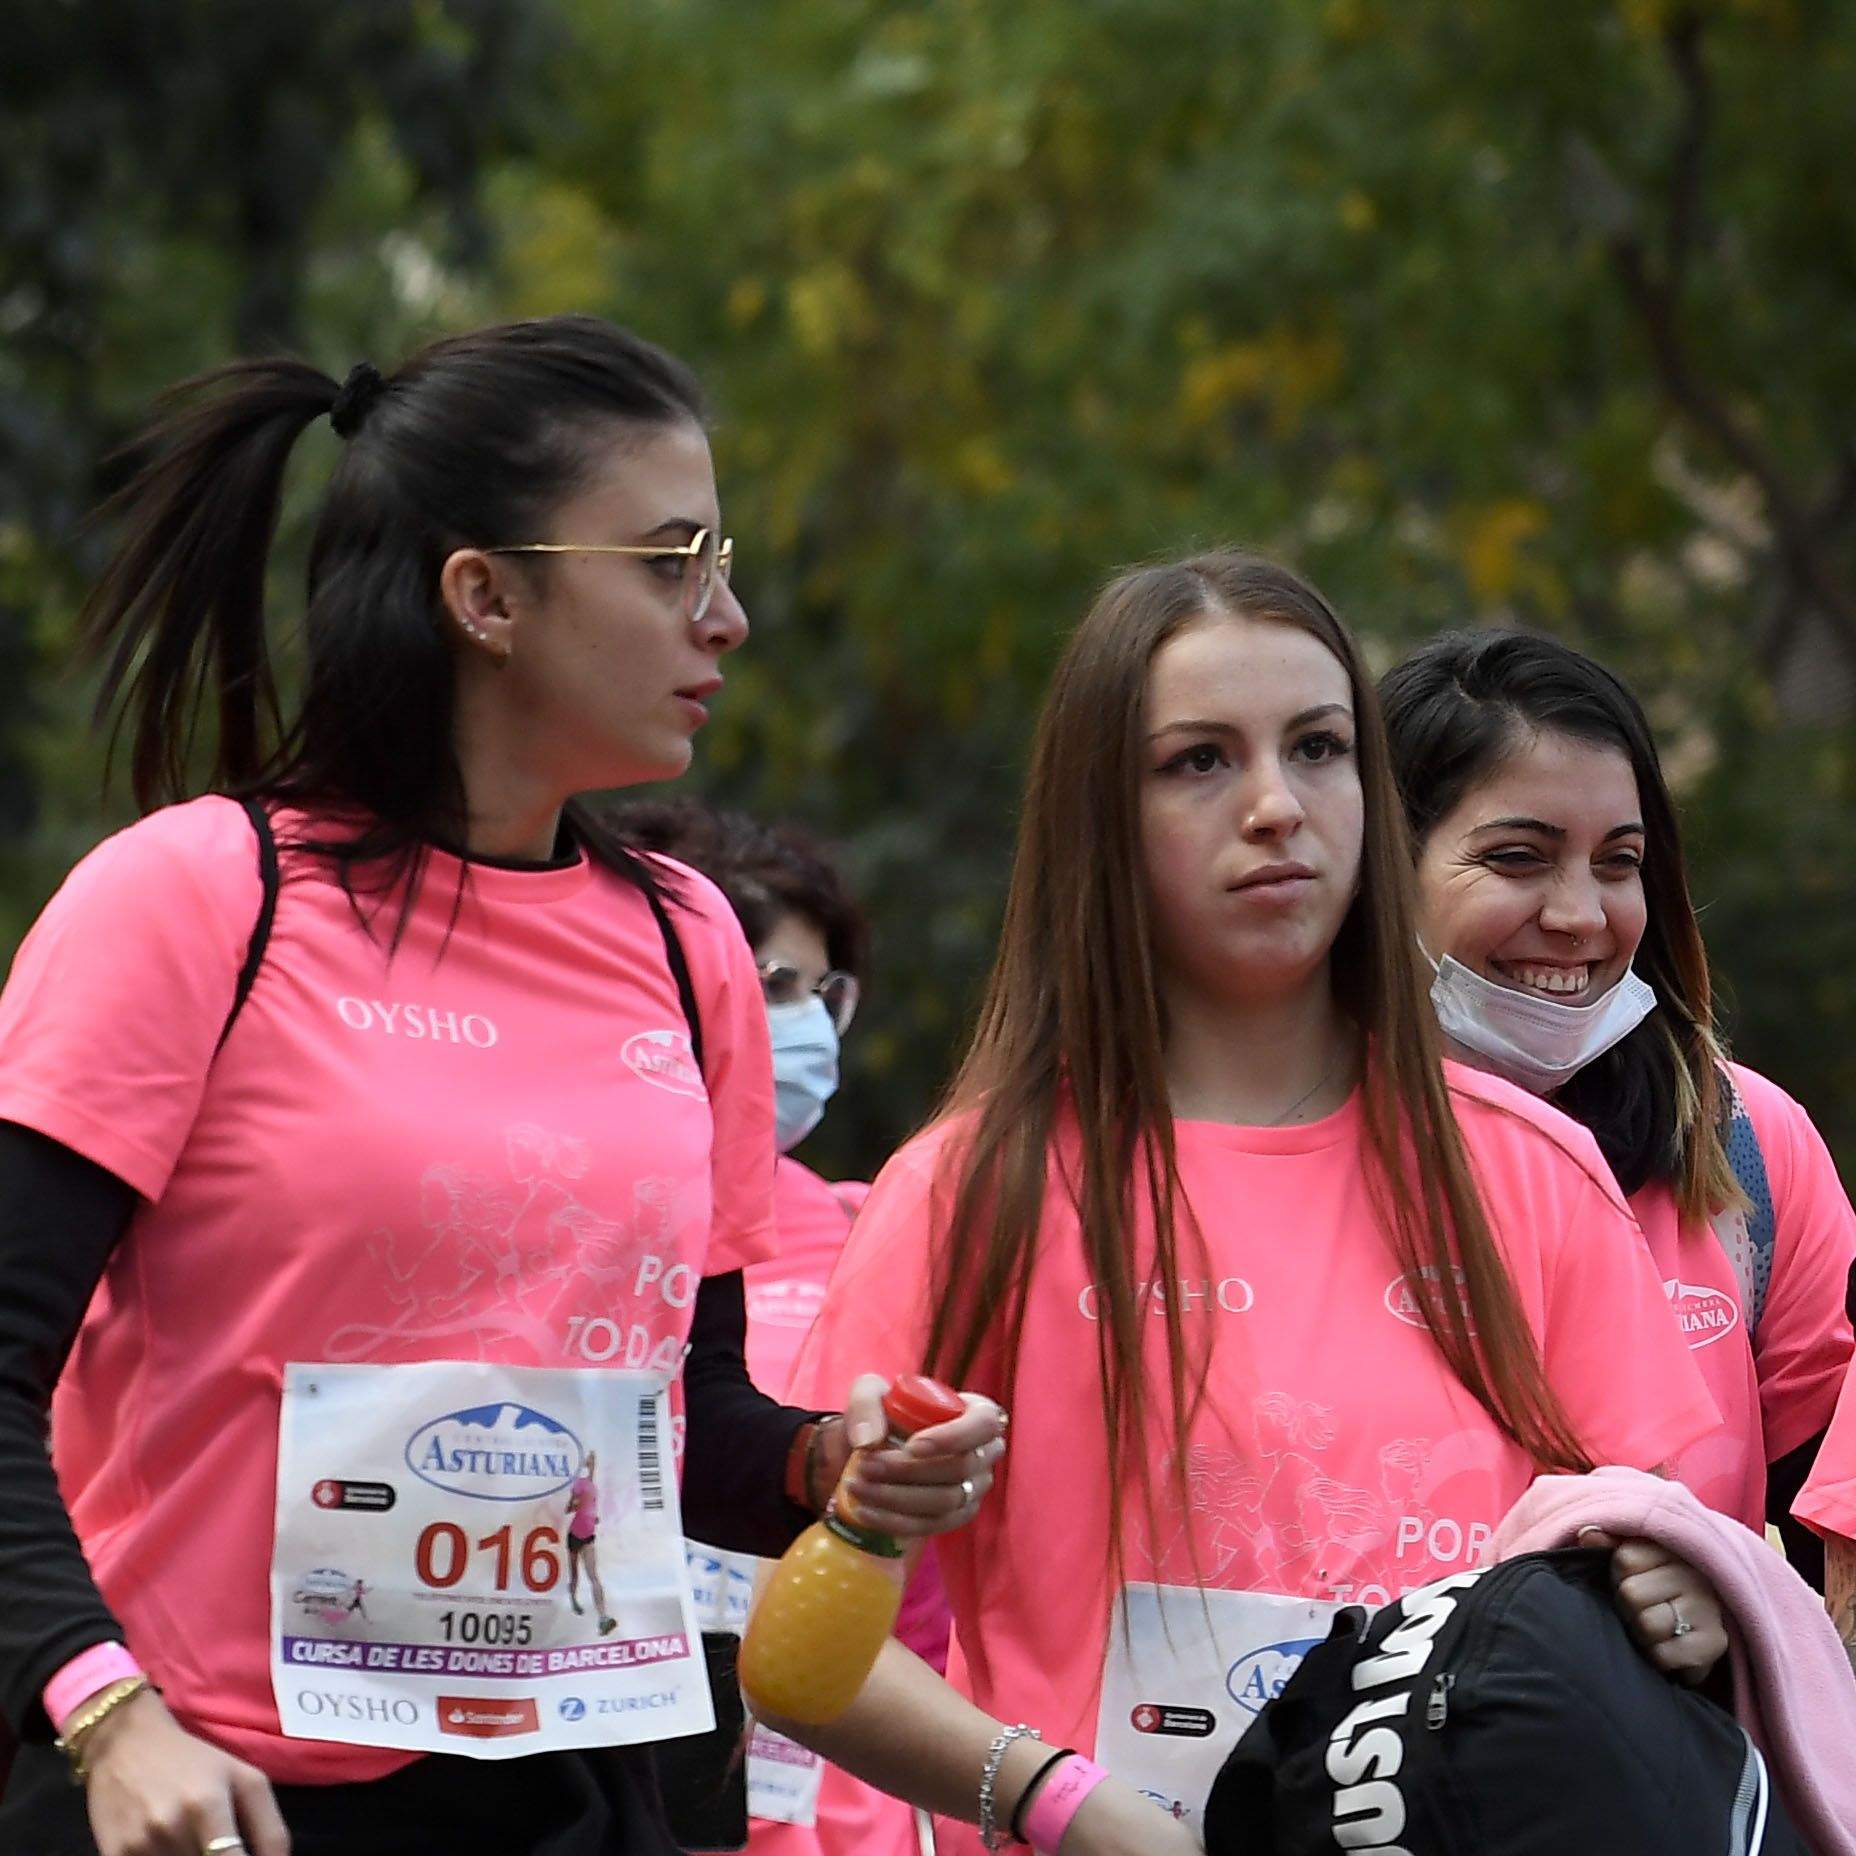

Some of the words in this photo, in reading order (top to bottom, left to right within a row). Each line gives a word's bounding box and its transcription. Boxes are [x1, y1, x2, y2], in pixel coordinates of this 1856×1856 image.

[337, 997, 498, 1048] OYSHO
[1680, 1307, 1729, 1332] IANA
[562, 1316, 692, 1375] TODA
[421, 1435, 570, 1477] ASTURIANA
[416, 1521, 560, 1593] 016
[291, 1641, 363, 1665] CURSA
[368, 1646, 397, 1668] DE
[401, 1647, 445, 1670] LES
[448, 1649, 513, 1673] DONES
[516, 1650, 543, 1673] DE
[548, 1638, 685, 1672] BARCELONA
[297, 1689, 419, 1726] OYSHO
[597, 1691, 677, 1714] ZURICH
